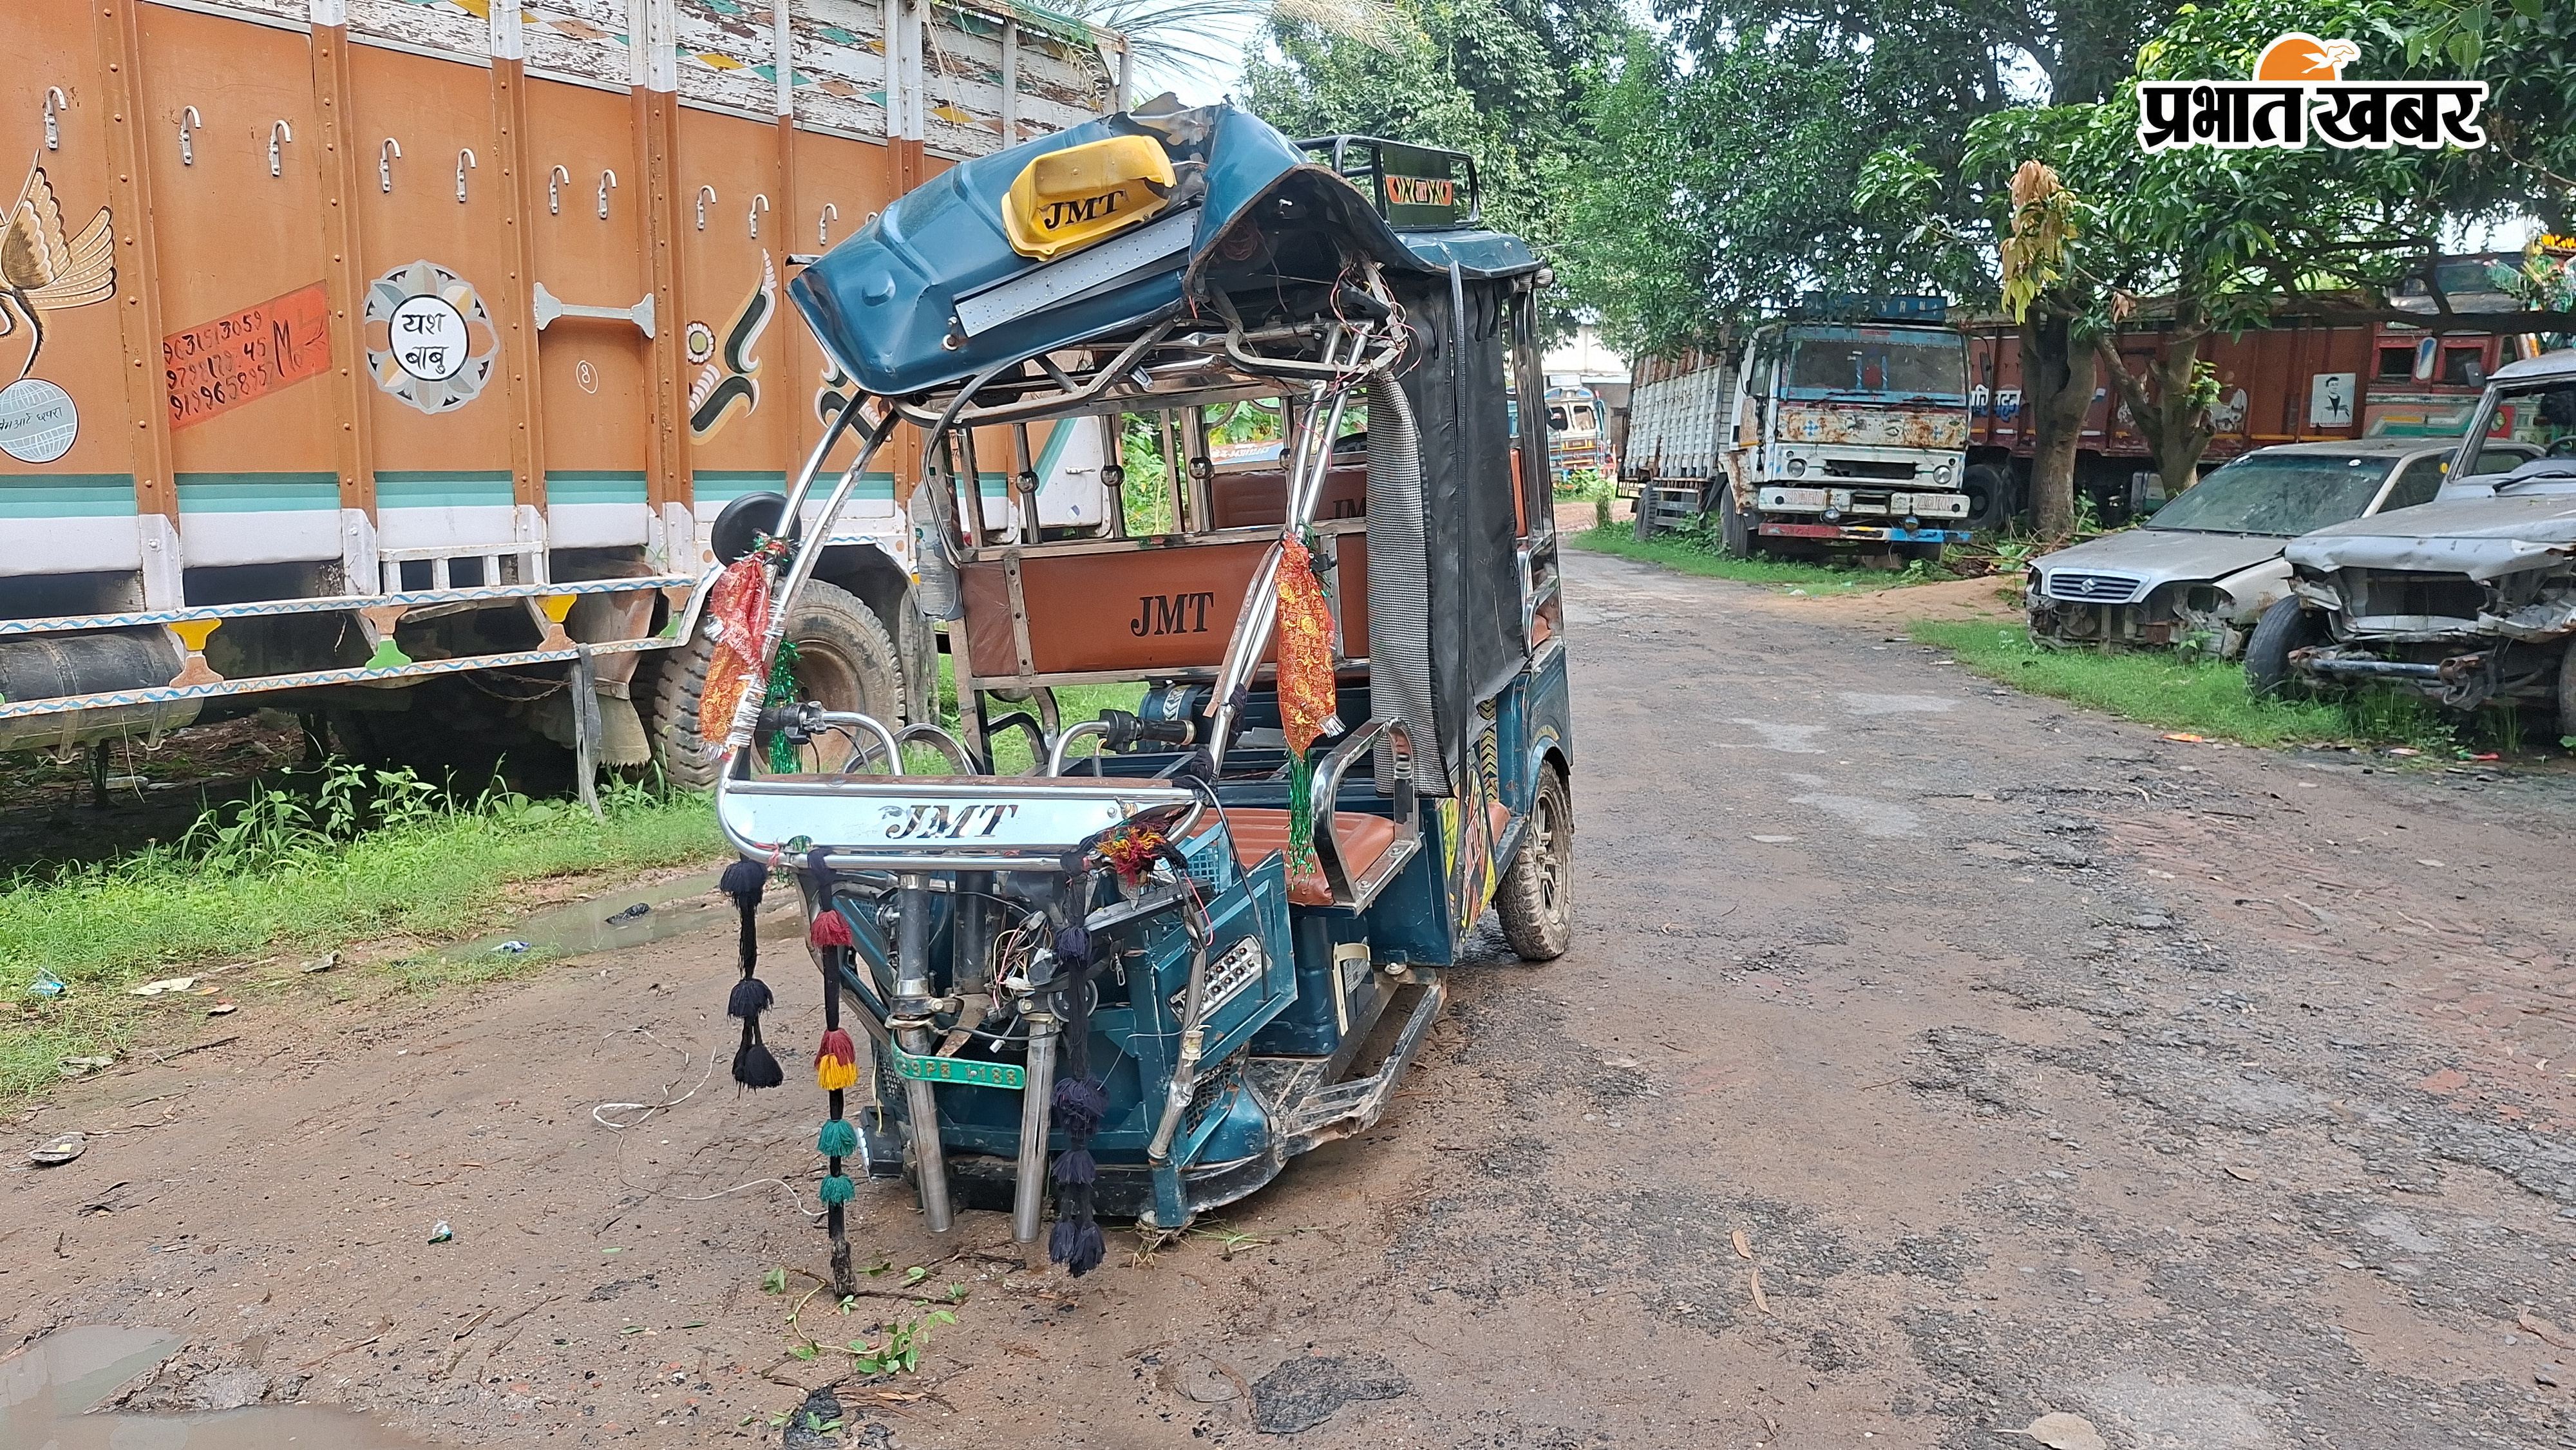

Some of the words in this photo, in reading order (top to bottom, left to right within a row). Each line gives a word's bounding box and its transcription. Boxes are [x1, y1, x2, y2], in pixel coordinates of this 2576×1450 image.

[1043, 190, 1125, 229] JMT
[401, 312, 448, 335] यश
[405, 346, 450, 375] बाबु
[581, 364, 591, 384] 8
[1332, 497, 1367, 519] JM
[1130, 592, 1215, 637] JMT
[885, 804, 1019, 840] JMT
